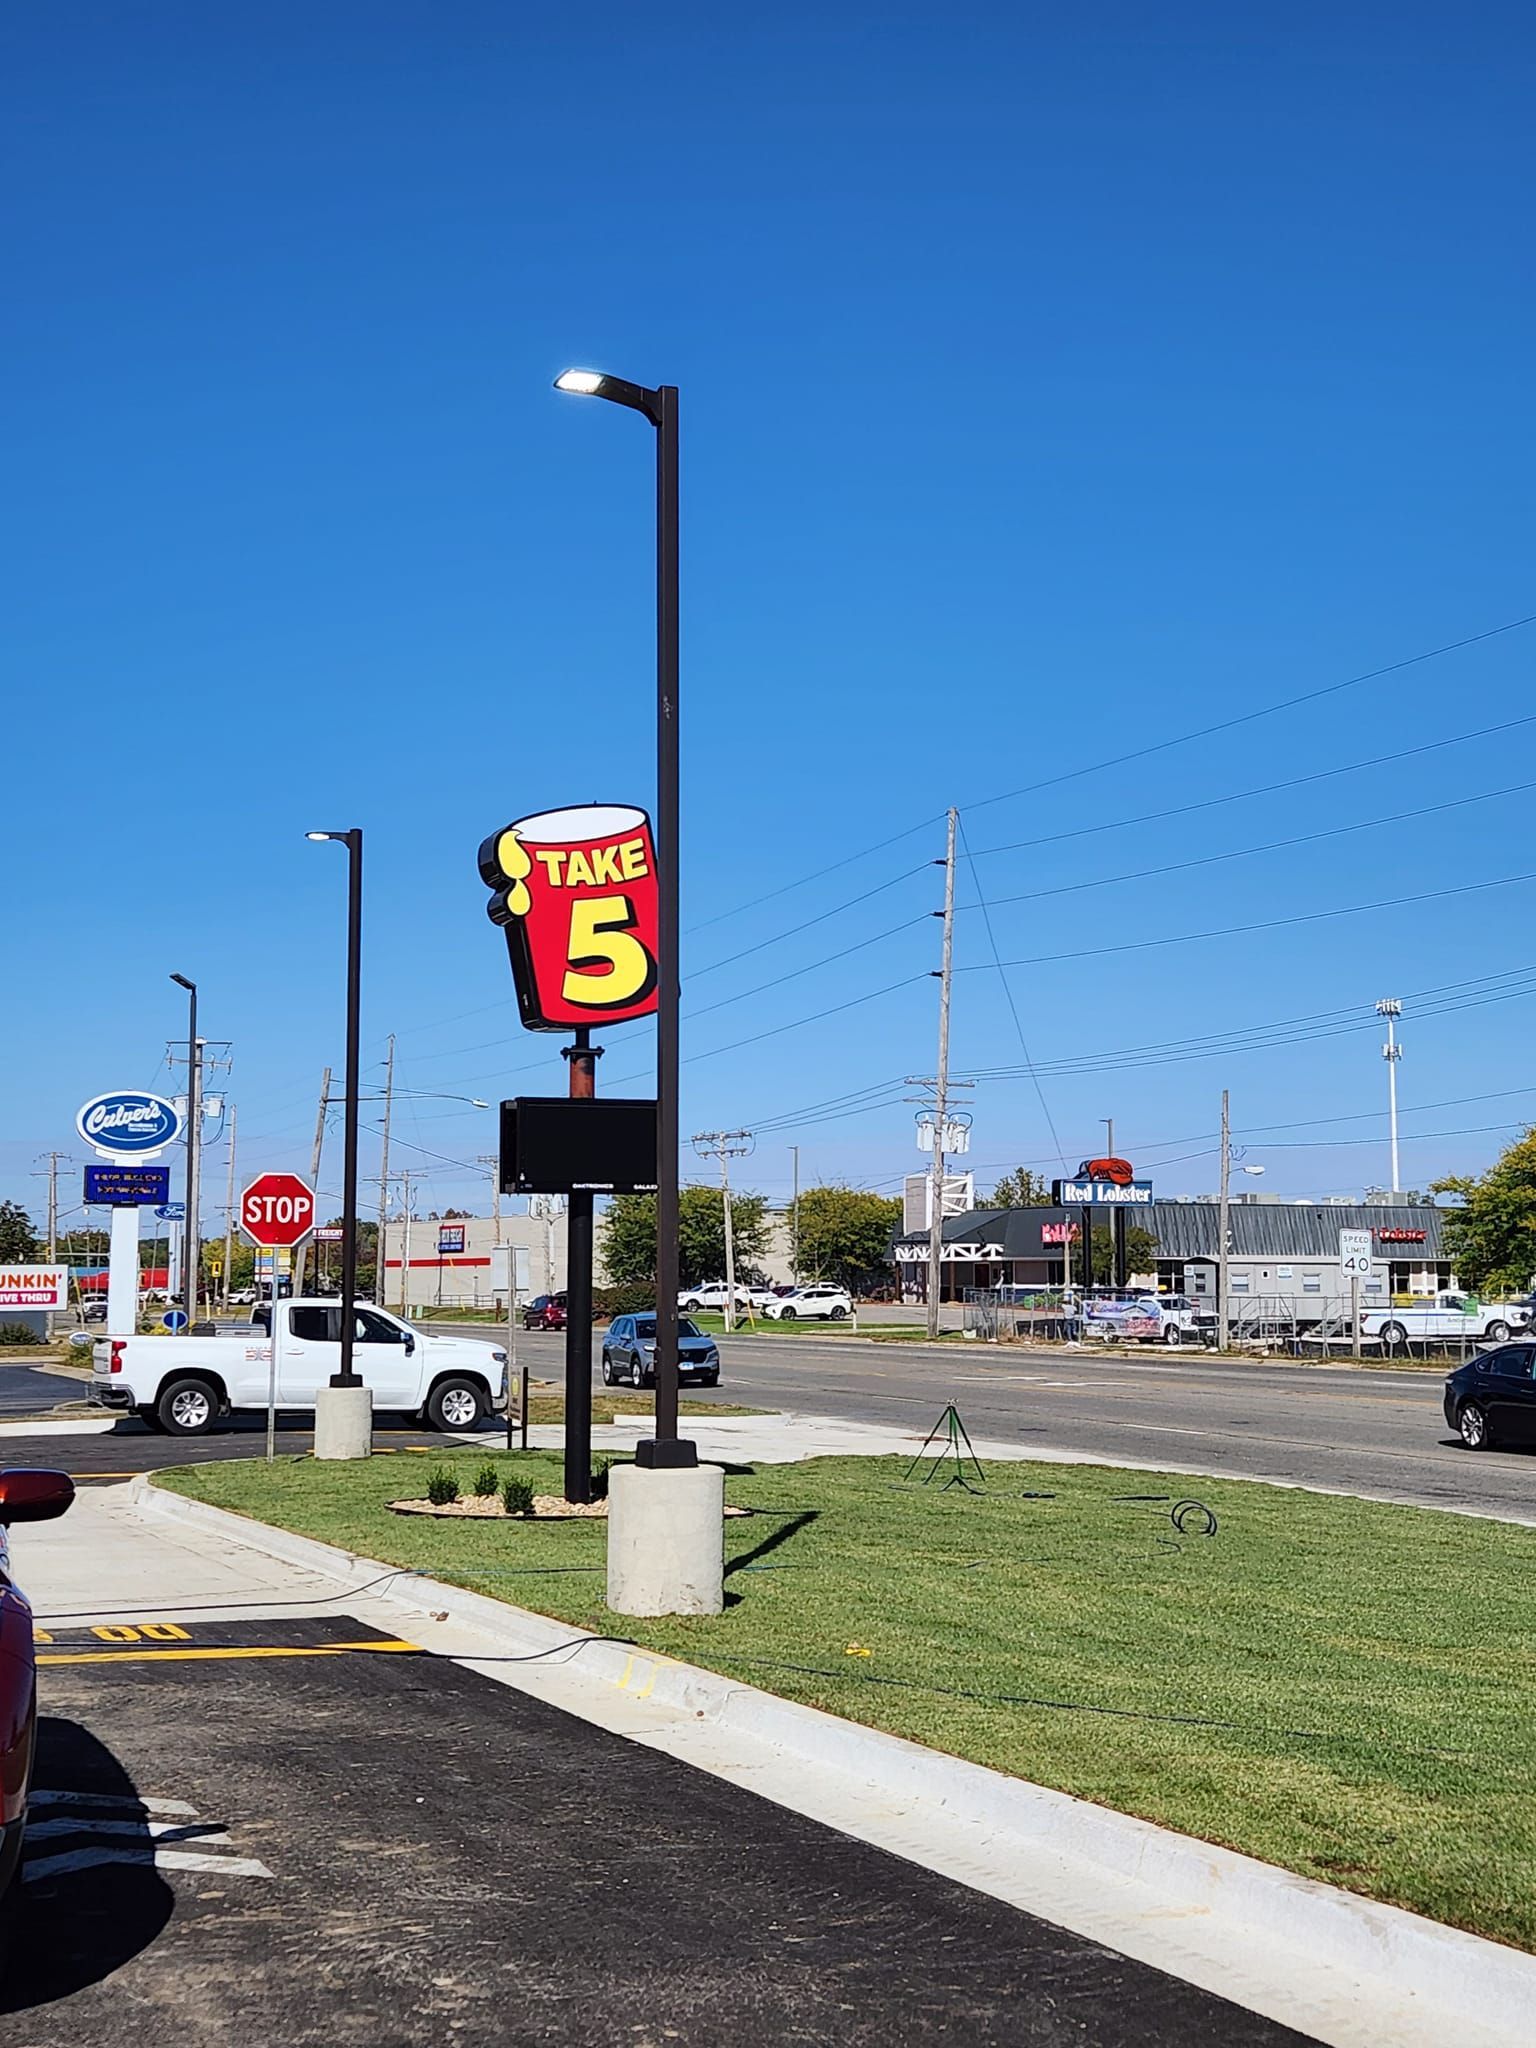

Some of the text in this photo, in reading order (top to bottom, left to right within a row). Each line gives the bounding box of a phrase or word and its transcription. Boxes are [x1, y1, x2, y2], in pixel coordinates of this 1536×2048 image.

[535, 838, 649, 888] TAKE
[560, 895, 655, 1009] 5
[86, 1100, 161, 1134] Culver's
[1065, 1183, 1151, 1202] Red Lobster
[163, 1206, 185, 1217] For
[246, 1196, 311, 1224] STOP
[1343, 1235, 1369, 1244] SPEED
[1346, 1246, 1366, 1254] LIMIT
[1344, 1256, 1369, 1272] 40
[0, 1273, 62, 1288] UNKIN'
[20, 1293, 51, 1303] THRU
